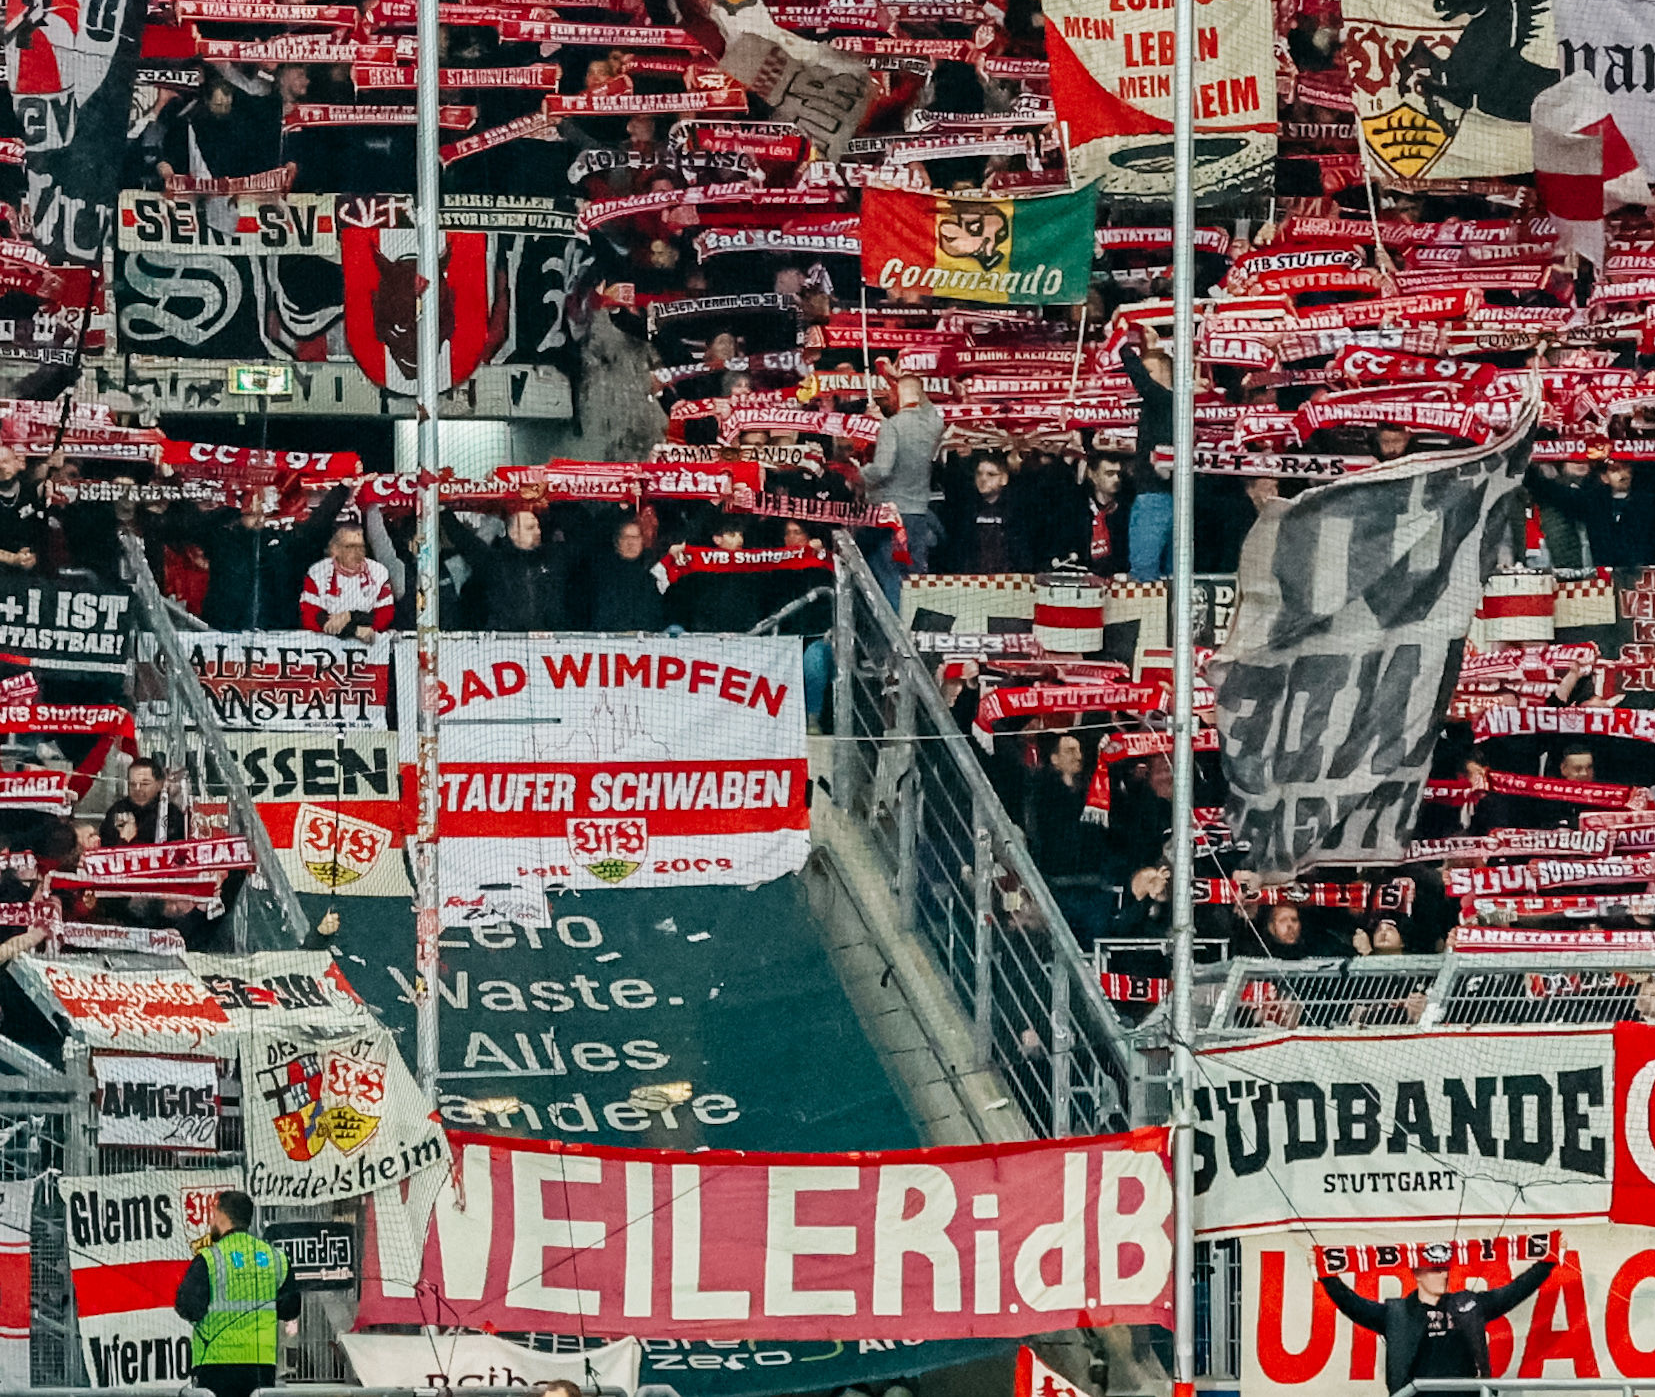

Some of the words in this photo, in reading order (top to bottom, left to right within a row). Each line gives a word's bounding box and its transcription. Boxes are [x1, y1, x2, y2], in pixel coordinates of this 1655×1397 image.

[1064, 17, 1114, 40] MEIN
[1124, 27, 1218, 67] LEBN
[1119, 75, 1170, 98] MEIN
[878, 256, 1062, 298] Commando
[1343, 351, 1394, 375] CC
[1435, 360, 1480, 379] 97
[189, 443, 238, 465] CC
[287, 451, 333, 471] 97
[701, 552, 730, 564] VfB
[735, 548, 805, 564] Stuttgart
[55, 589, 129, 632] IST
[547, 652, 788, 718] WIMPFEN
[34, 706, 125, 727] Stuttgart
[436, 773, 574, 816] TAUFER
[589, 769, 792, 812] SCHWABEN
[304, 814, 378, 862] VfB
[574, 818, 641, 855] VfB
[462, 1029, 669, 1073] Alles
[1194, 1065, 1607, 1196] SÜDBANDE
[249, 1137, 442, 1198] Gundelsheim
[1323, 1170, 1458, 1196] STUTTGART
[70, 1192, 173, 1247] Glems
